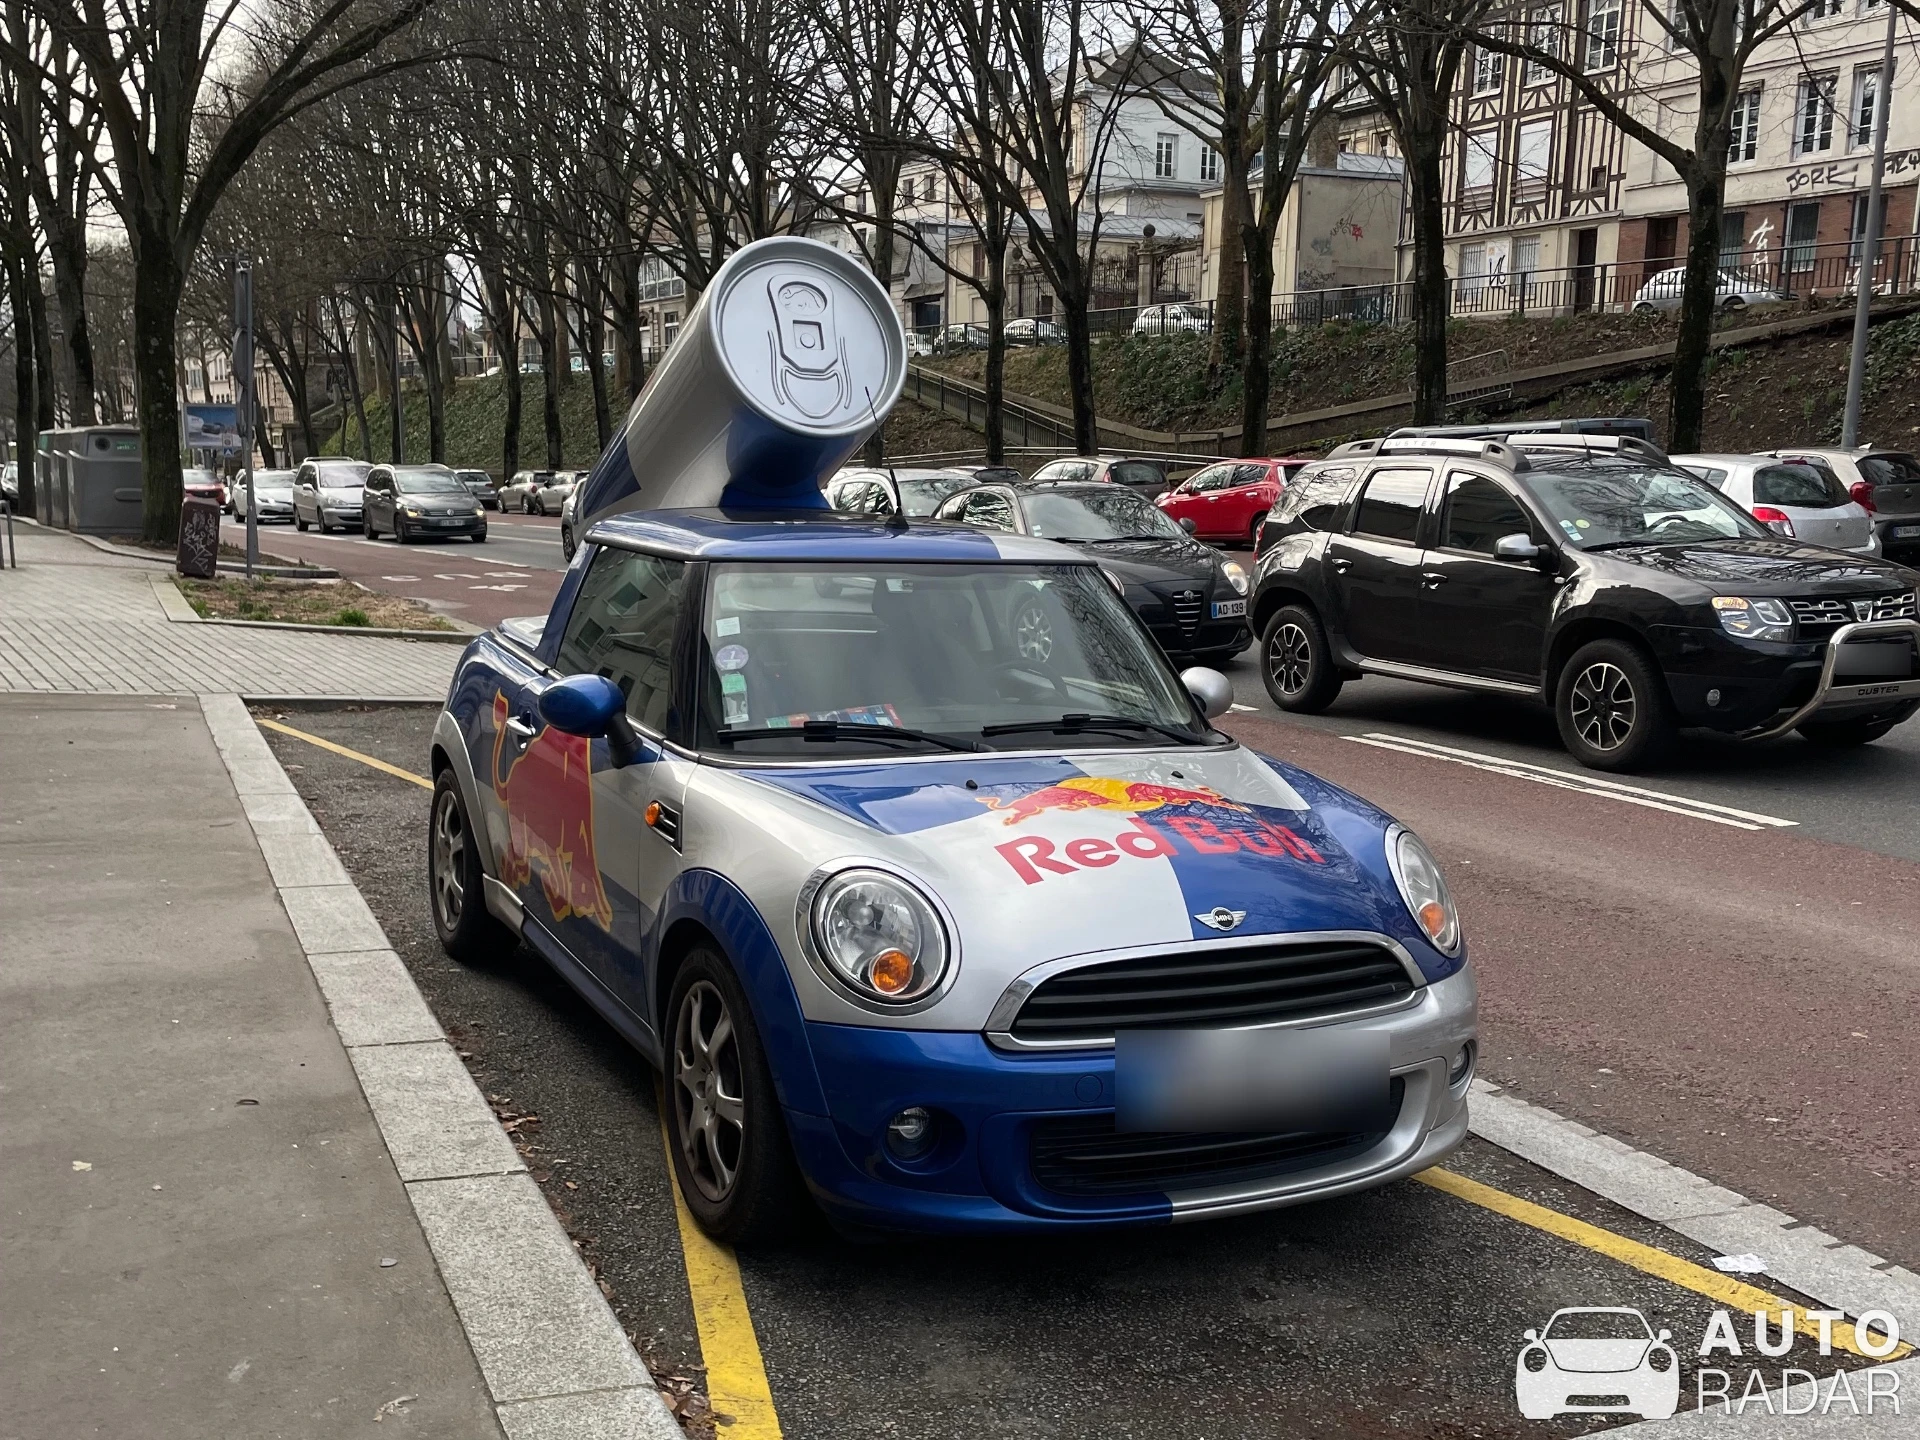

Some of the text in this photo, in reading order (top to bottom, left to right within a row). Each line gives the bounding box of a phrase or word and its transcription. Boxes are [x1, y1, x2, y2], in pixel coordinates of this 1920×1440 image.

[1857, 685, 1900, 696] DUSTER
[993, 815, 1326, 886] Red Bull
[1214, 913, 1233, 922] MINI
